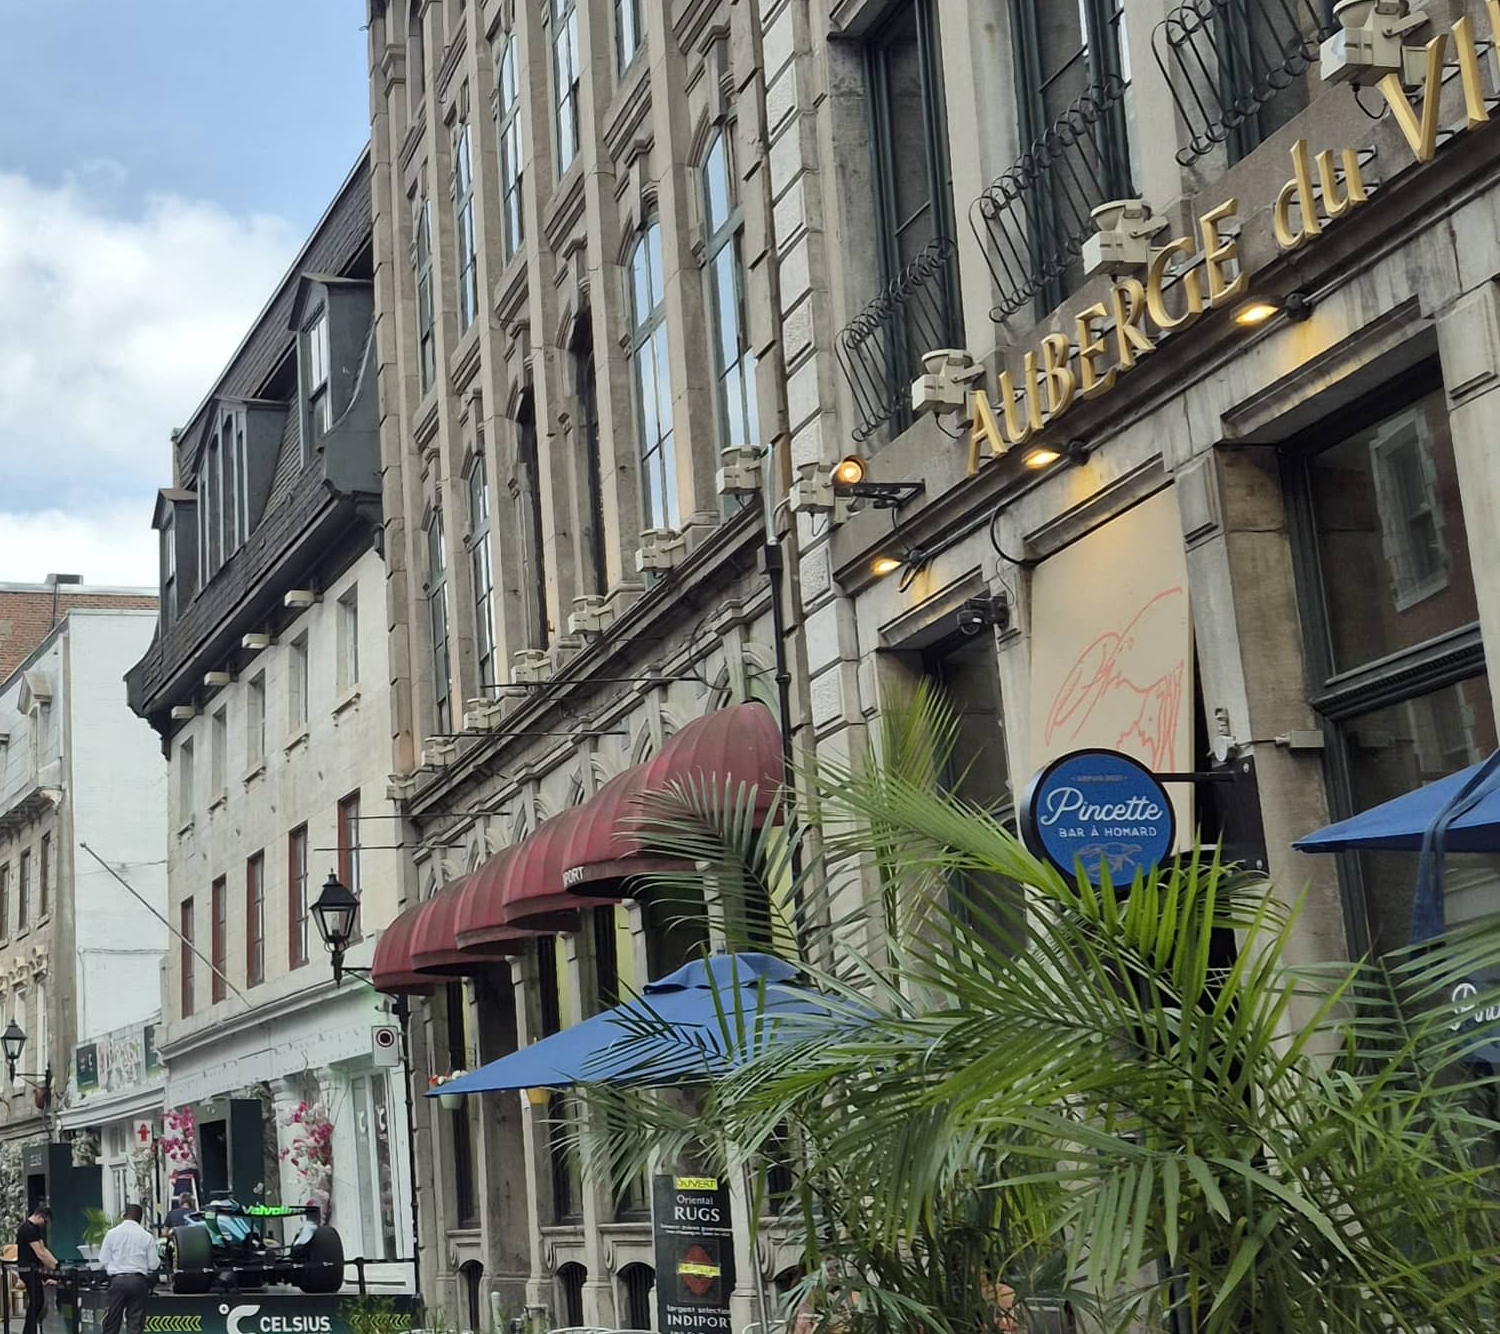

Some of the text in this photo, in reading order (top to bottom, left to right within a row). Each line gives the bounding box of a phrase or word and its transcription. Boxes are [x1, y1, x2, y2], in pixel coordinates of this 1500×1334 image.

[966, 198, 1250, 476] AUBERGE
[1273, 139, 1368, 251] du
[1040, 787, 1163, 825] Pincette
[1059, 824, 1157, 837] BAR À HOMARD
[676, 1194, 714, 1205] Oriental
[674, 1206, 720, 1222] RUGS
[260, 1315, 333, 1333] CELSIUS
